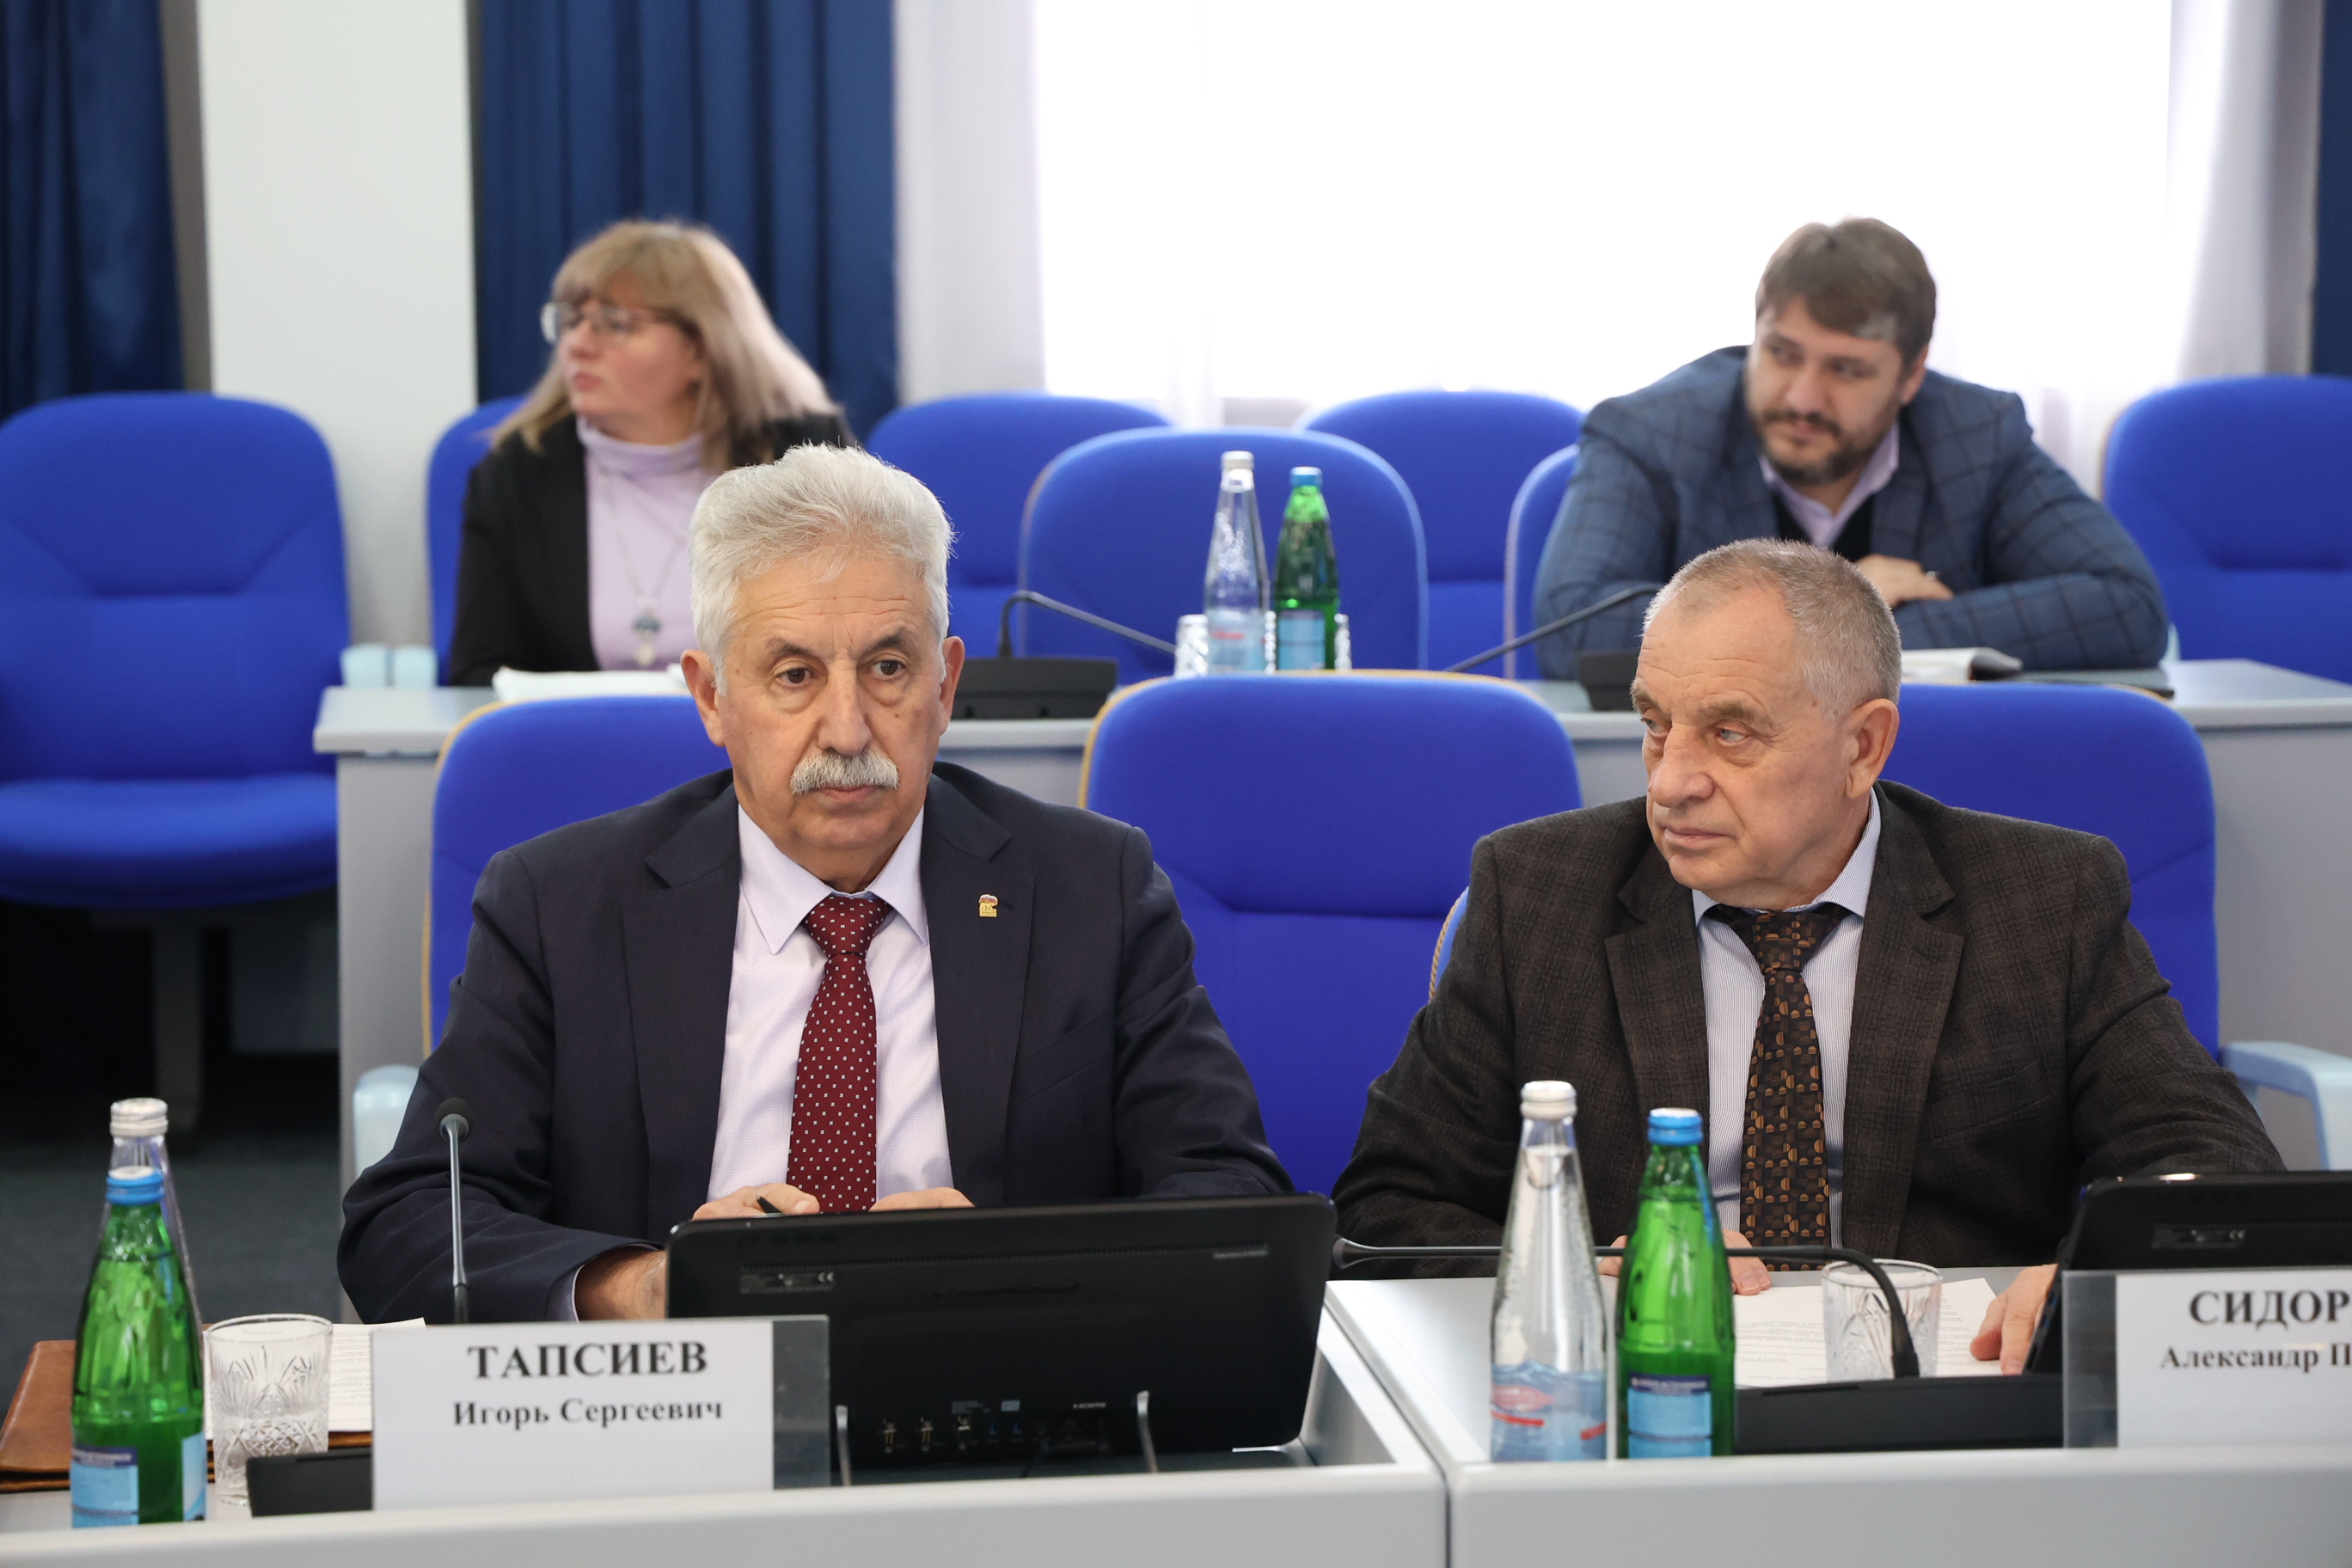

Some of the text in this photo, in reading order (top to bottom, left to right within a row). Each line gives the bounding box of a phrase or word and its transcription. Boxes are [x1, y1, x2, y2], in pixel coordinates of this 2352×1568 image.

[2190, 1289, 2351, 1330] СИДОР
[467, 1341, 708, 1379] ТАПСИЕВ
[2159, 1346, 2319, 1375] Александр
[453, 1397, 723, 1431] Игорь Сергеевич
